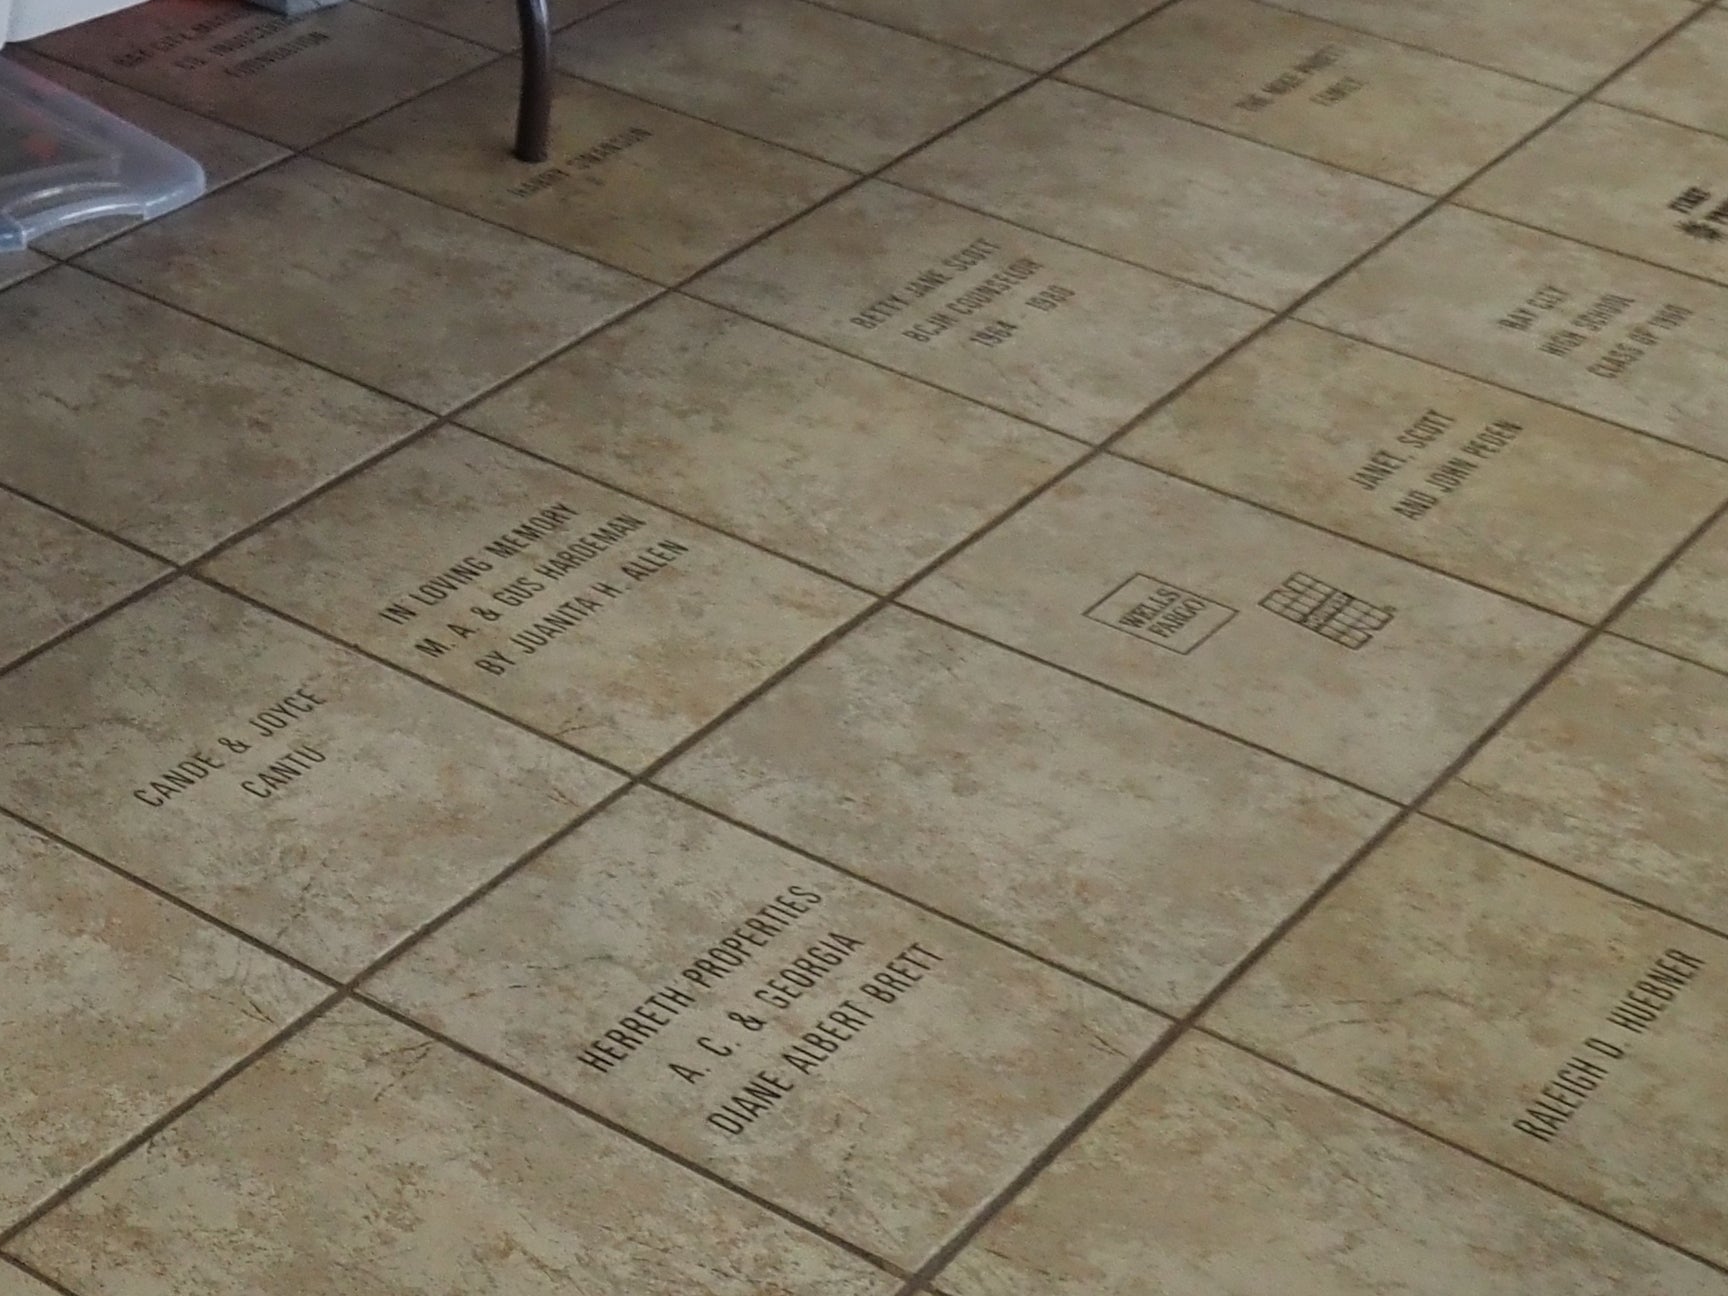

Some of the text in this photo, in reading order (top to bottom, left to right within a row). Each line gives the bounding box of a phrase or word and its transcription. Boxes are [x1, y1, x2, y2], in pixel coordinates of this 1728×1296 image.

[849, 237, 1002, 329] BETTY JANE SCOTT
[945, 258, 1045, 316] COUNSELOR
[1570, 293, 1636, 332] SCHOOL
[1585, 342, 1646, 379] CLASS
[1396, 409, 1457, 449] SCOTT
[1391, 489, 1439, 521] AND
[1425, 457, 1479, 493] JOHN
[378, 501, 580, 625] IN LOVING MEMORY
[470, 606, 503, 622] &
[493, 576, 545, 607] GUS
[534, 512, 648, 581] HARDEMAN
[474, 650, 516, 676] BY
[510, 595, 604, 655] JUANITA
[621, 539, 689, 582] ALLEN
[1119, 586, 1181, 629] WELLS
[133, 688, 327, 807] CANDE & JOYCE
[240, 745, 326, 798] CANTU
[578, 885, 822, 1073] HERRETH PROPERTIES
[668, 931, 866, 1085] A. C. & GEORGIA
[706, 942, 944, 1136] DIANE ALBERT BRETT
[1512, 1056, 1609, 1143] RALEIGH
[1606, 947, 1707, 1034] HUEBNER
